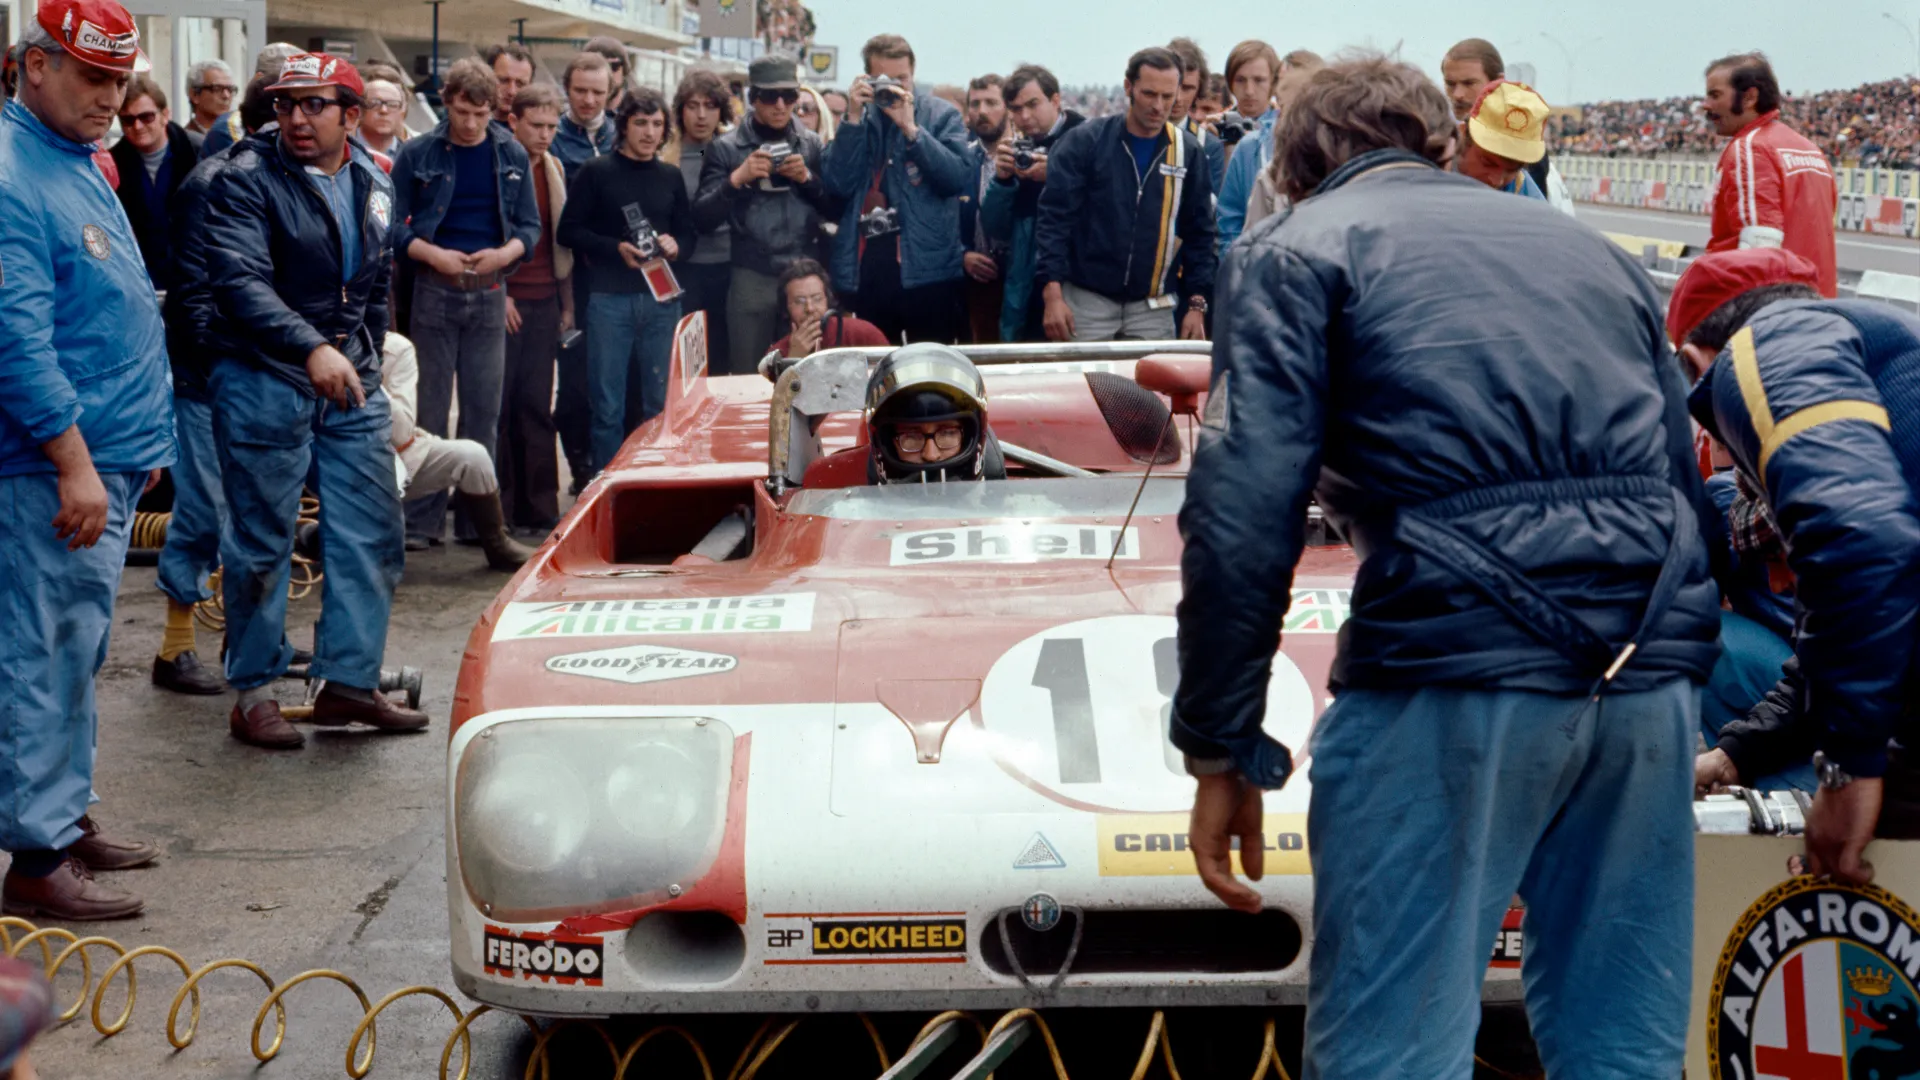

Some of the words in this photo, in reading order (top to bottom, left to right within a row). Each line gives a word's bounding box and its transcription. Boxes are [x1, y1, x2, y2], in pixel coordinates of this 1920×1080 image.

[904, 529, 1127, 560] Shell
[516, 611, 782, 636] Alitalia
[1031, 637, 1188, 784] 1
[814, 926, 965, 949] LOCKHEED
[487, 938, 601, 974] FERODO
